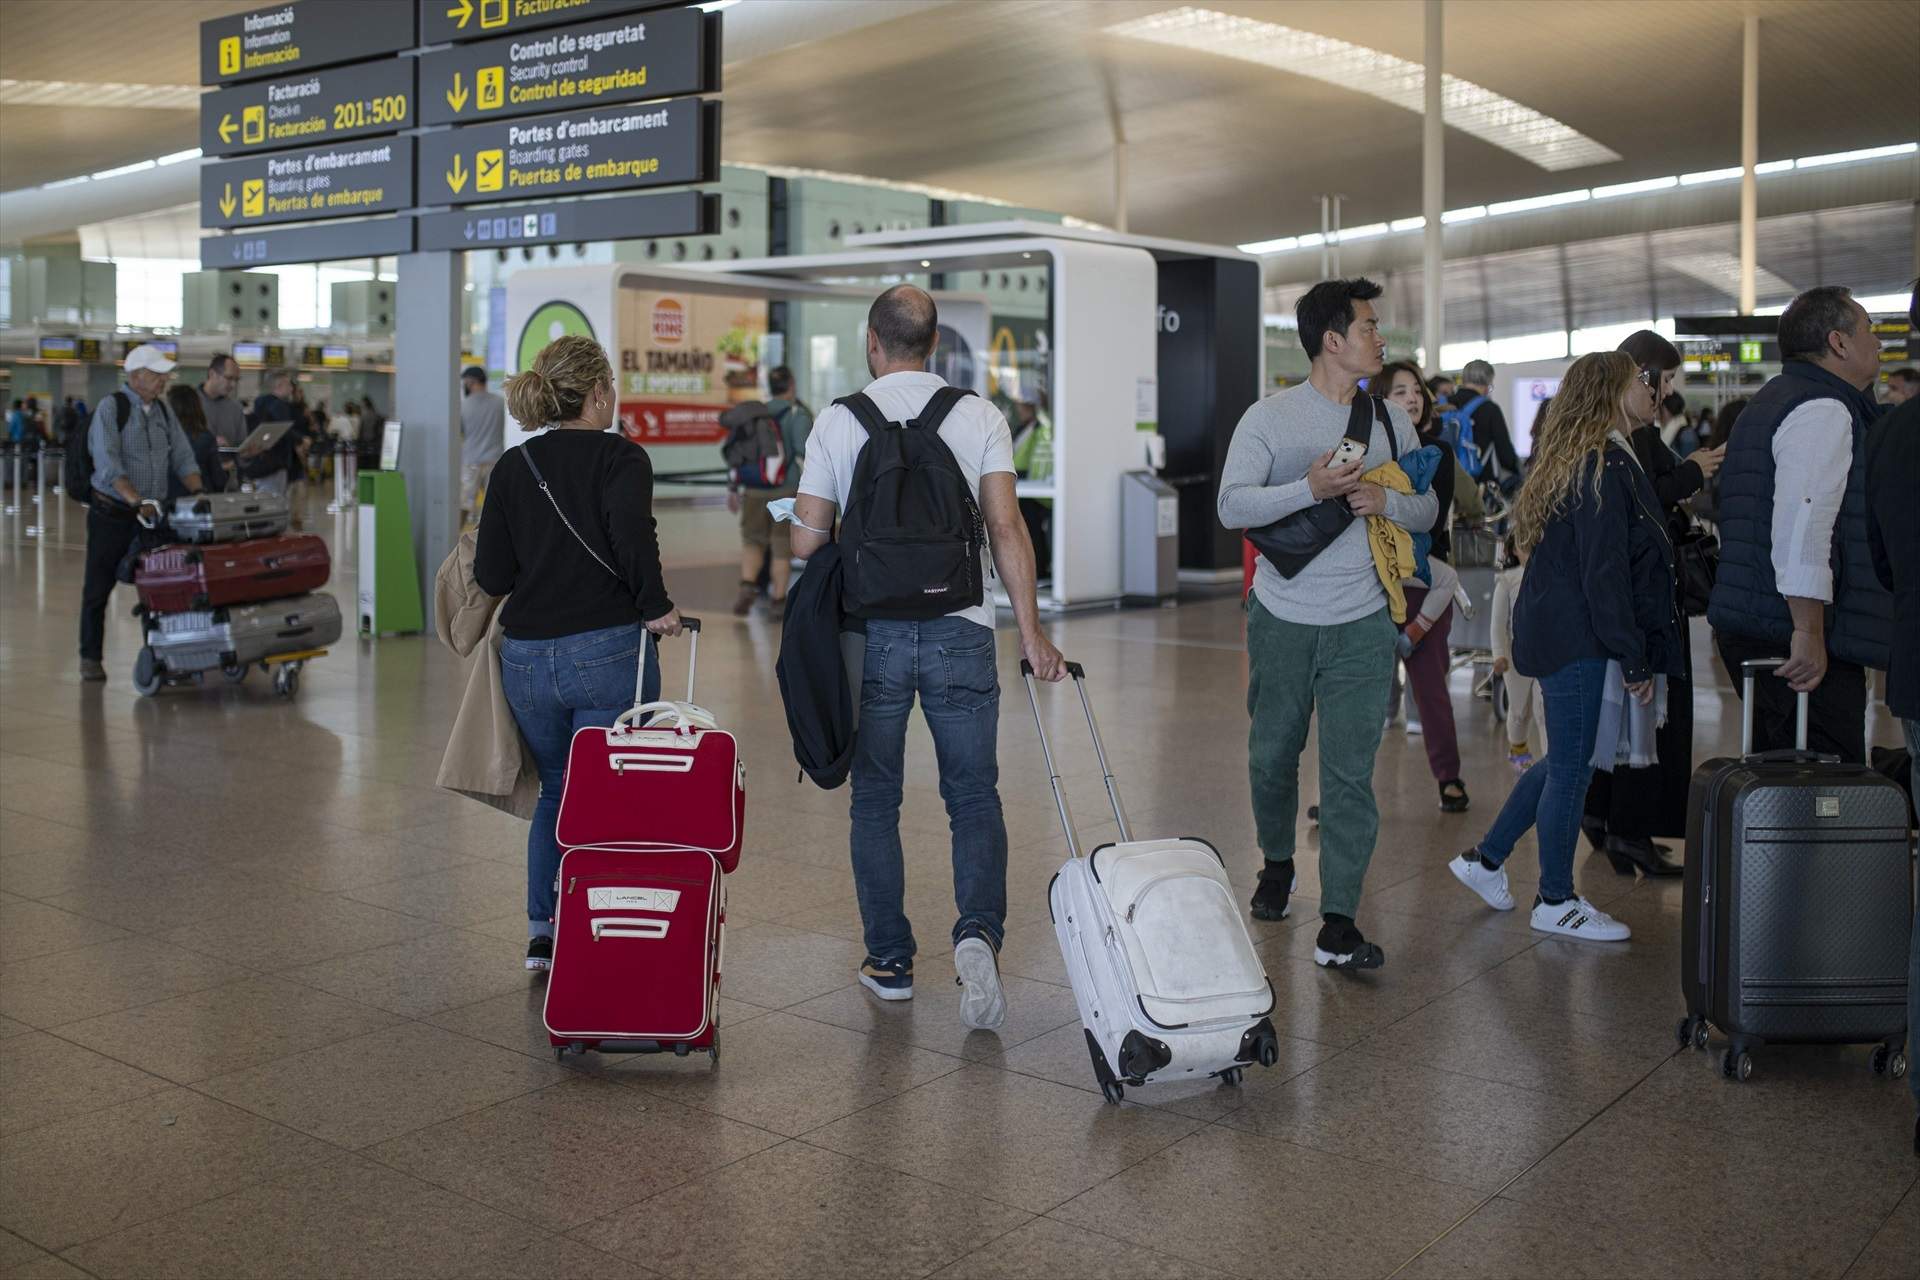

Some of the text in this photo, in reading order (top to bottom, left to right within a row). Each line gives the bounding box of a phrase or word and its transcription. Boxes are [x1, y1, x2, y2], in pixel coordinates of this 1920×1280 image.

[244, 6, 294, 32] Informació
[513, 0, 591, 17] Facturaci
[244, 30, 291, 50] Information
[510, 23, 646, 62] Control de seguretat
[244, 44, 300, 69] Información
[510, 54, 588, 81] Security control
[269, 78, 320, 102] Facturació
[510, 66, 646, 104] Control de seguridad
[269, 116, 326, 138] Facturación
[509, 109, 669, 146] Portes d'embarcament
[509, 143, 590, 166] Boarding gates
[268, 159, 303, 177] Portes
[509, 158, 659, 187] Puertas de embarque
[268, 175, 330, 194] Boarding gates
[268, 188, 383, 213] Puertas de embarque
[622, 348, 714, 374] EL TAMAÑO
